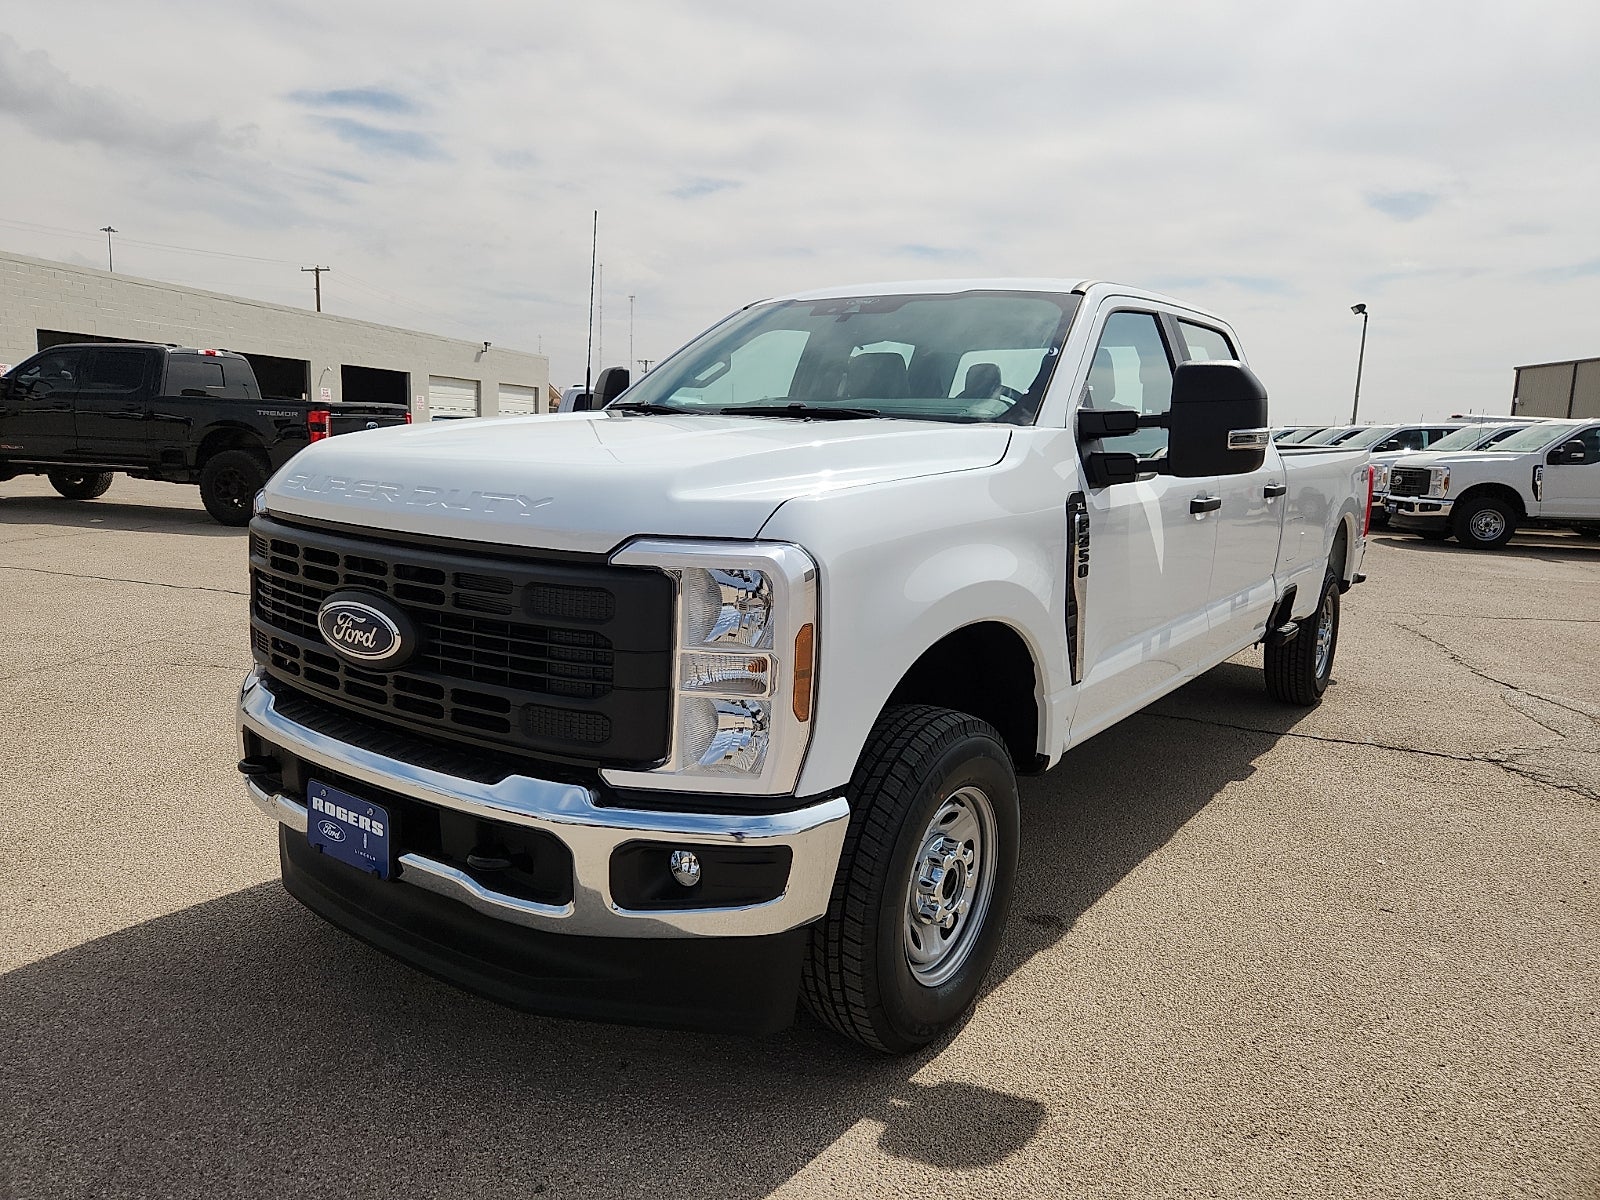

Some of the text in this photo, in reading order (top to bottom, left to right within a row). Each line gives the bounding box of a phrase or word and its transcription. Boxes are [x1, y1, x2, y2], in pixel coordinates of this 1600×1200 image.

[256, 409, 298, 418] TREMOR
[284, 472, 555, 517] SUPER DUTY
[332, 611, 377, 648] Ford
[312, 796, 384, 837] ROGERS
[322, 822, 341, 840] Ford
[354, 848, 376, 862] LINCOLN
